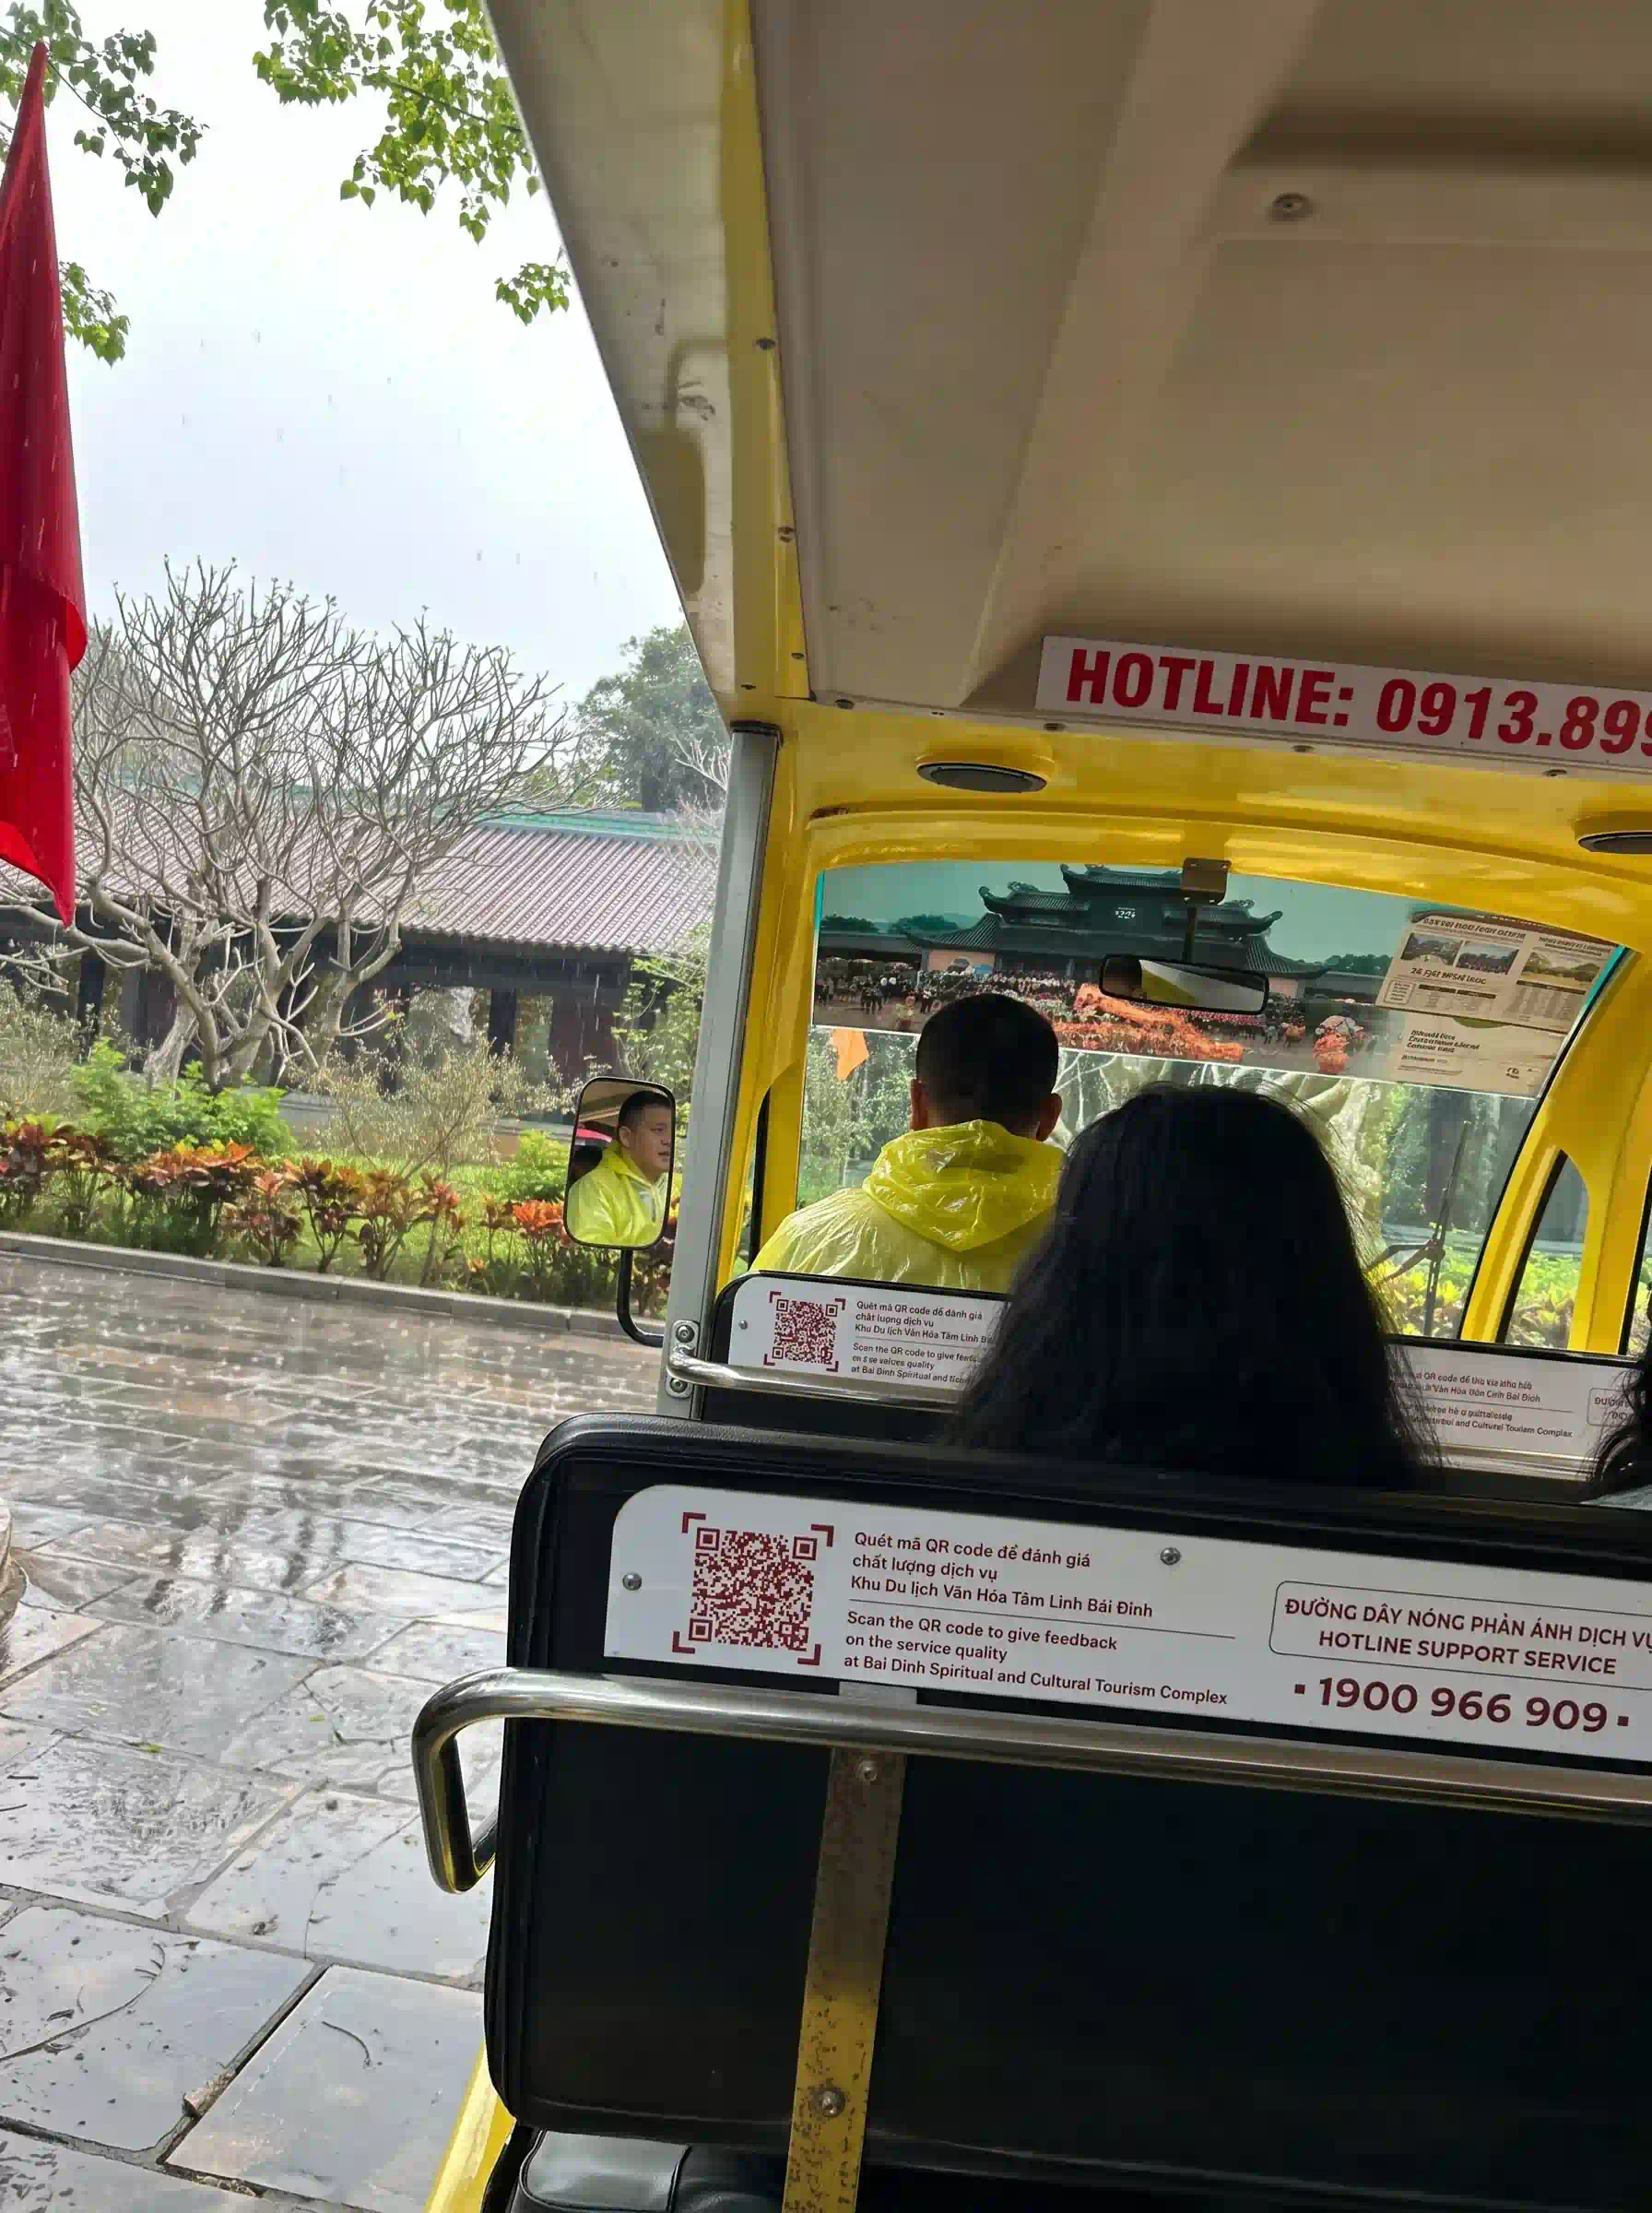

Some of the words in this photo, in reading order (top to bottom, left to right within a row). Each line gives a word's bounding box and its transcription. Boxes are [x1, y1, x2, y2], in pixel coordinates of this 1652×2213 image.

[1067, 648, 1354, 727] HOTLINE:
[1376, 679, 1652, 757] 0913.89
[853, 1553, 888, 1569] chất
[891, 1557, 936, 1578] lượng
[940, 1562, 974, 1580] dịch
[979, 1568, 997, 1582] vụ
[855, 1532, 892, 1548] Quét
[897, 1537, 921, 1551] mã
[926, 1538, 950, 1554] QR
[953, 1543, 994, 1558] code
[1021, 1547, 1062, 1565] đánh
[1066, 1553, 1091, 1568] giá
[851, 1575, 880, 1592] Khu
[885, 1579, 907, 1593] Du
[911, 1581, 938, 1598] lịch
[943, 1584, 972, 1601] Văn
[976, 1587, 1008, 1604] Hóa
[1012, 1592, 1045, 1607] Tâm
[1050, 1594, 1083, 1611] Linh
[1087, 1597, 1113, 1614] Bái
[847, 1611, 885, 1627] Scan
[889, 1615, 914, 1630] the
[918, 1618, 941, 1633] QR
[946, 1622, 984, 1637] code
[988, 1626, 1004, 1639] to
[1008, 1627, 1040, 1643] give
[1045, 1629, 1118, 1651] feedback
[1285, 1597, 1357, 1620] ĐƯỜNG
[1363, 1603, 1402, 1625] DÂY
[1408, 1608, 1465, 1631] NÓNG
[1470, 1613, 1525, 1637] PHẢN
[1529, 1617, 1573, 1641] ÁNH
[1578, 1626, 1626, 1648] DỊCH
[845, 1635, 864, 1647] on
[868, 1635, 893, 1650] the
[896, 1639, 951, 1655] service
[955, 1645, 1008, 1663] quality
[1319, 1630, 1412, 1655] HOTLINE
[1417, 1639, 1519, 1664] SUPPORT
[1524, 1650, 1617, 1675] SERVICE
[844, 1655, 859, 1668] at
[864, 1655, 887, 1671] Bai
[891, 1658, 926, 1675] Dinh
[929, 1662, 993, 1681] Spiritual
[997, 1671, 1026, 1685] and
[1030, 1672, 1091, 1691] Cultural
[1095, 1678, 1155, 1698] Tourism
[1160, 1685, 1227, 1705] Complex
[1319, 1677, 1418, 1714] 1900
[1431, 1686, 1512, 1723] 966
[1526, 1697, 1608, 1734] 909
